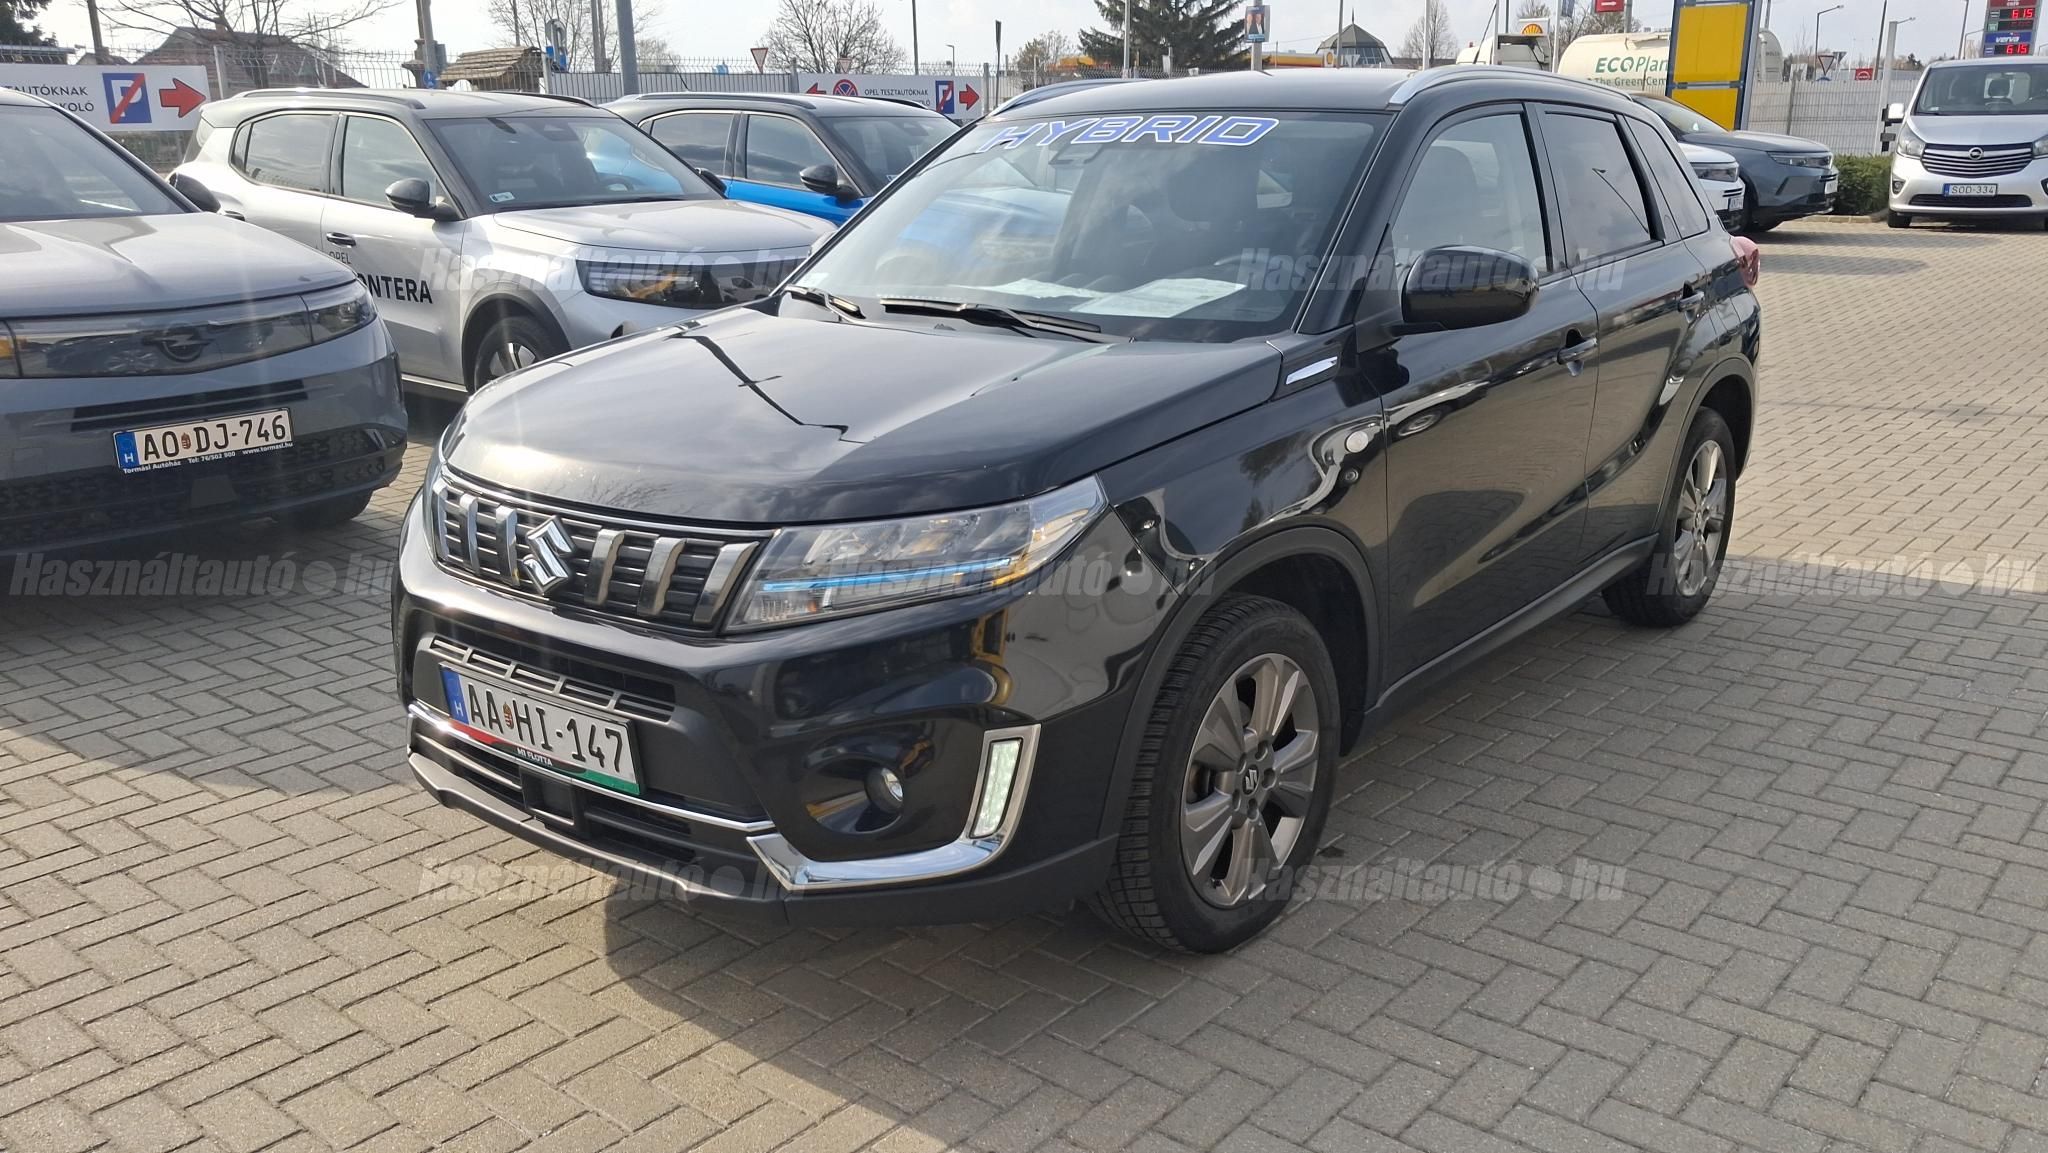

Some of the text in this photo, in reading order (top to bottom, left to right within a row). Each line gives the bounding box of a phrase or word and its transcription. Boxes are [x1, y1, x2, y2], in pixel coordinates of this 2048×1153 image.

[1614, 77, 1643, 87] Green
[864, 88, 879, 96] OPEL
[976, 115, 1280, 153] HYBRID
[144, 414, 286, 461] AO DJ-746
[124, 452, 134, 463] H
[455, 701, 464, 717] H
[467, 683, 623, 773] AA HI-147
[527, 751, 553, 767] FLOTTA
